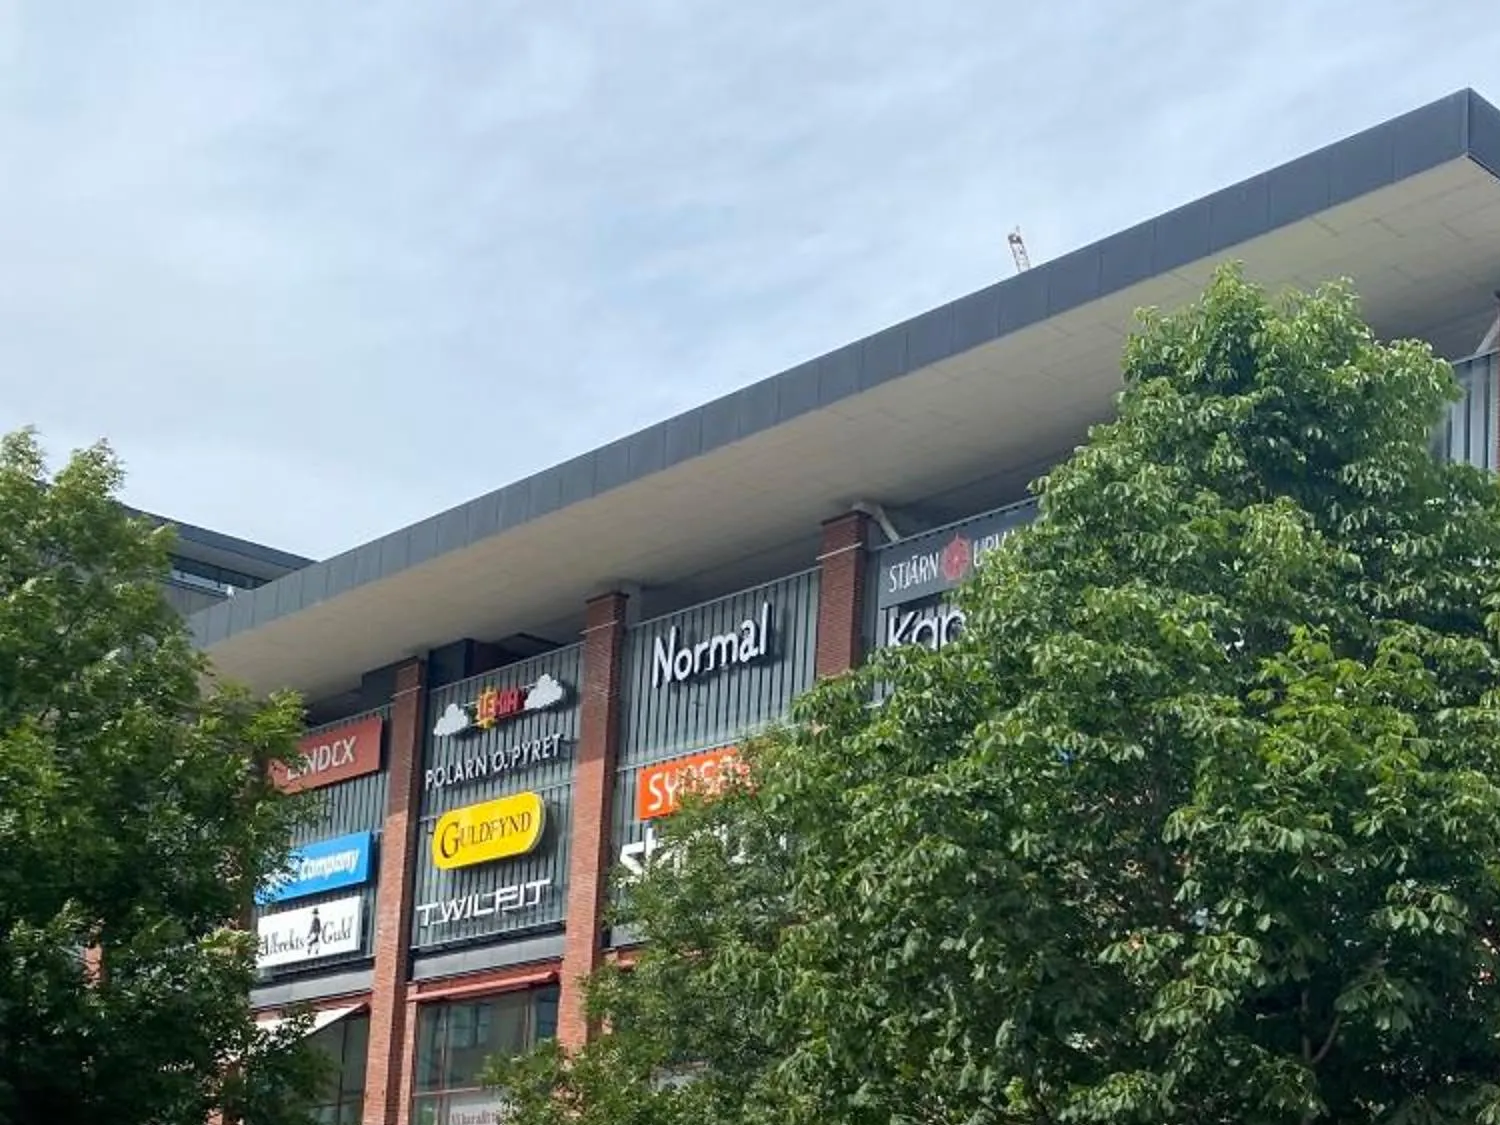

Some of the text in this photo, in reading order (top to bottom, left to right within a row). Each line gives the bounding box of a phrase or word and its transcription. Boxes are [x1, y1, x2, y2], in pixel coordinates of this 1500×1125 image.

[652, 602, 769, 689] Normal
[287, 735, 357, 781] LNDEX
[425, 755, 487, 791] POLARN
[321, 915, 355, 946] Guld
